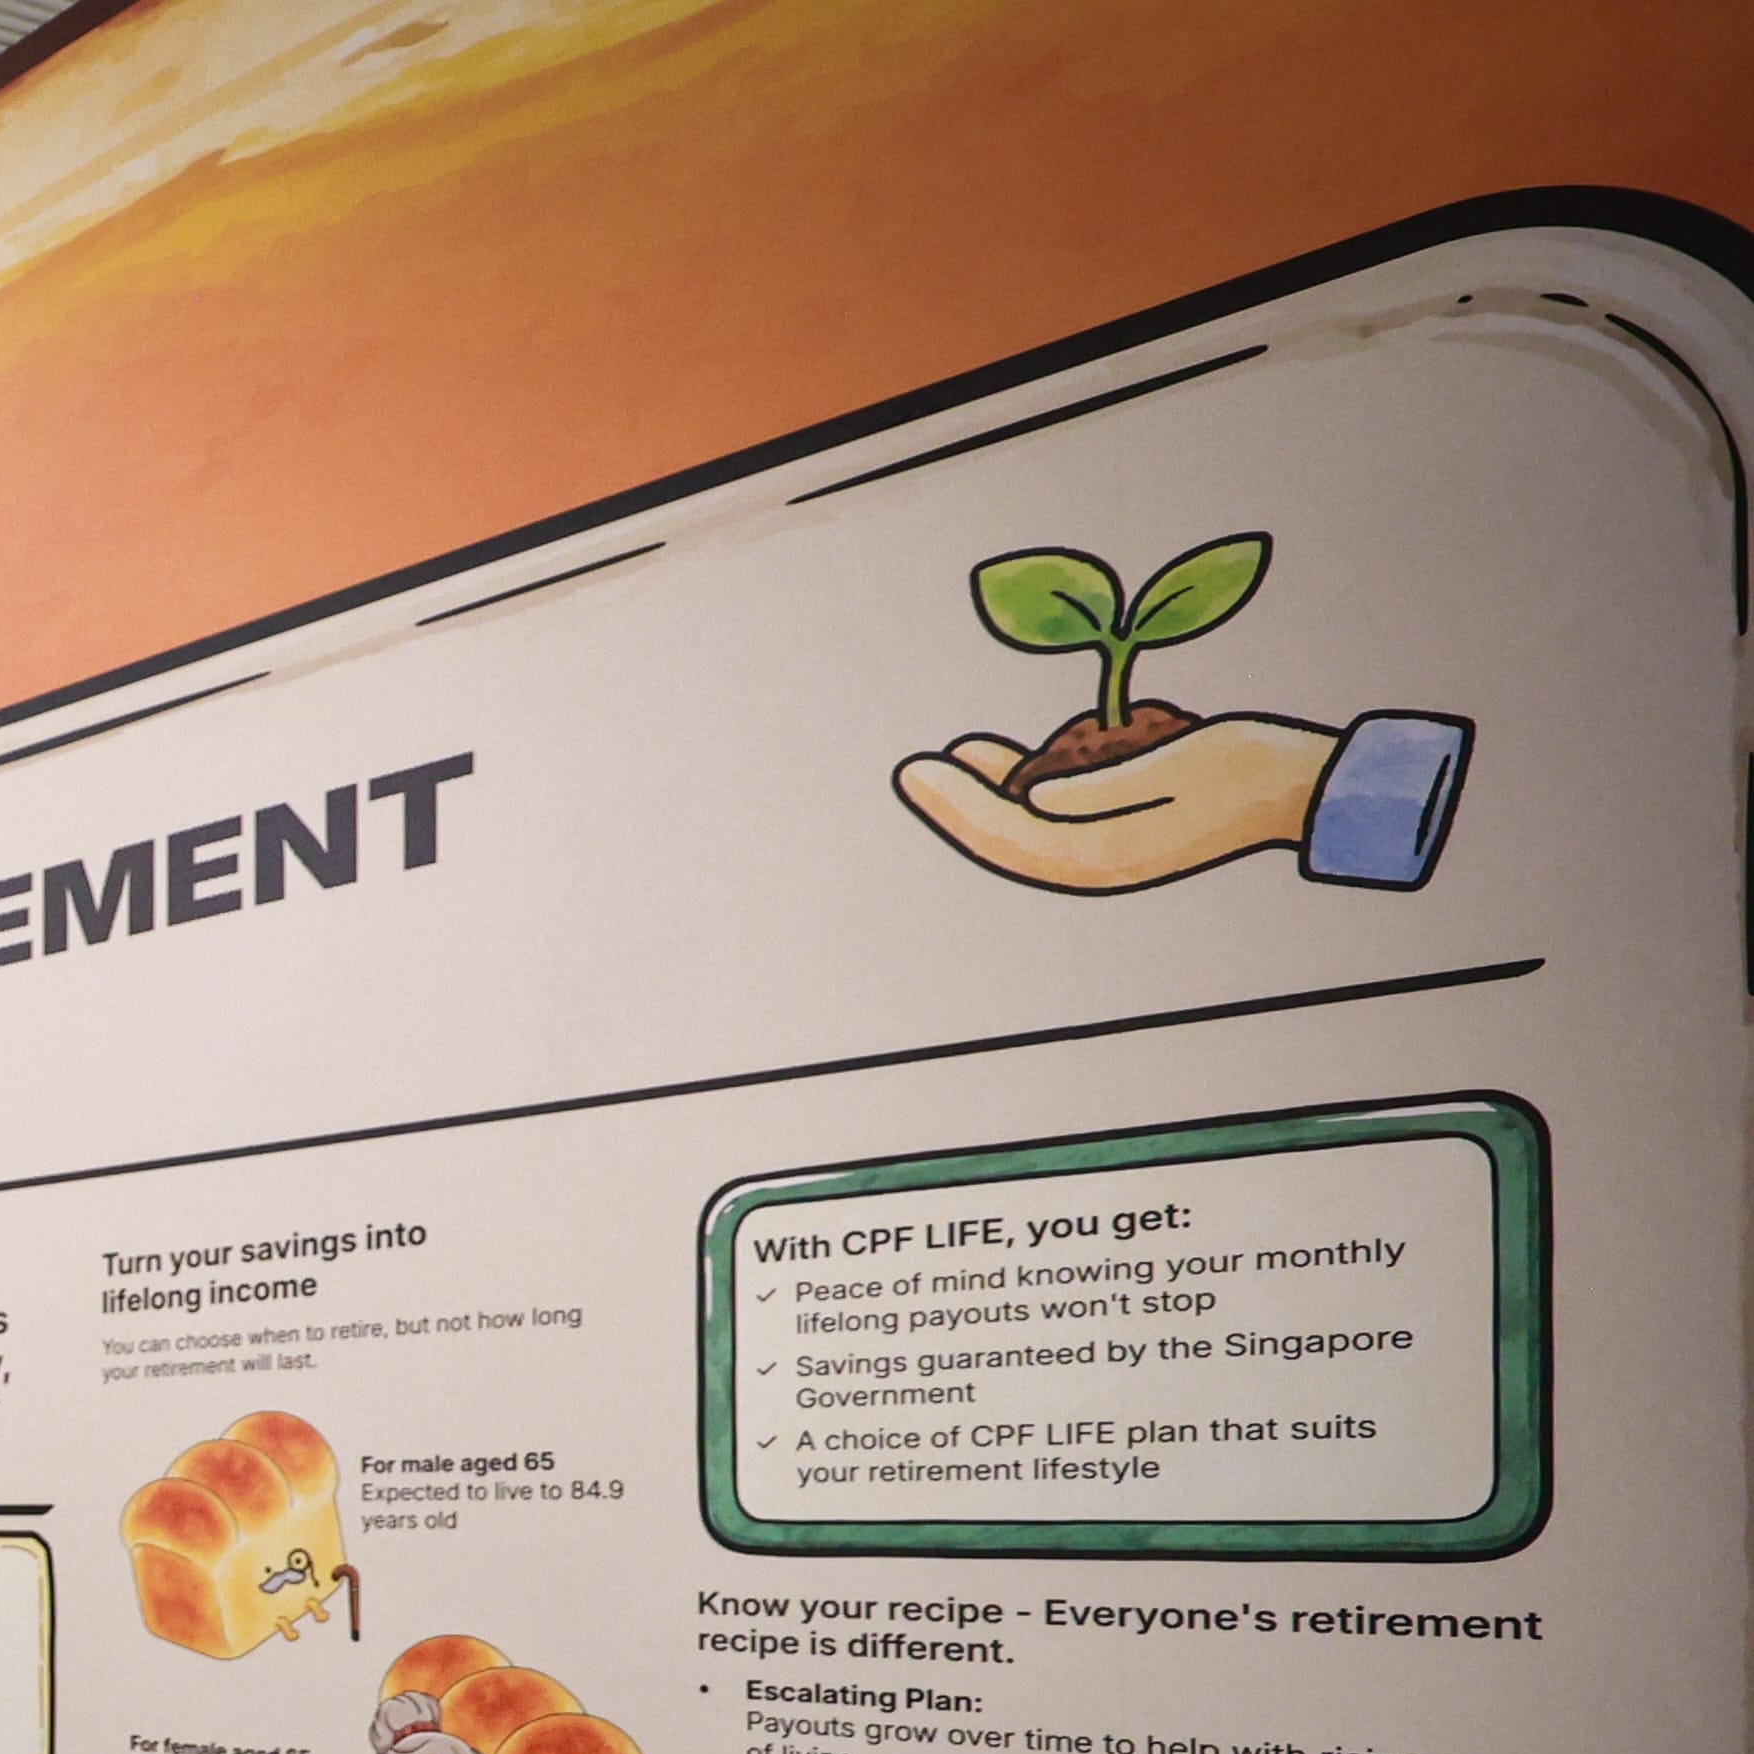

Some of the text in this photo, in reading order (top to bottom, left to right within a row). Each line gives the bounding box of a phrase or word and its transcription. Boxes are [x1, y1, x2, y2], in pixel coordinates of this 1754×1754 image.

[102, 1223, 426, 1276] Turn your savings into
[753, 1203, 1190, 1263] With CPF LIFE, you get:
[796, 1238, 1405, 1302] Peace of mind knowing your monthly
[103, 1277, 316, 1313] lifelong income
[797, 1291, 1215, 1334] lifelong payouts won't stop
[796, 1330, 1412, 1378] Savings guaranteed by the Singapore
[796, 1382, 975, 1408] Government
[795, 1414, 1376, 1451] A choice of CPF LIFE plan that suits
[361, 1451, 554, 1475] For male aged 65
[797, 1455, 1159, 1487] your retirement lifestyle
[698, 1591, 789, 1616] Know
[800, 1599, 877, 1624] your
[888, 1596, 1002, 1629] recipe
[1045, 1599, 1277, 1634] Everyone's
[1292, 1605, 1542, 1640] retirement
[698, 1628, 1013, 1663] recipe is different.
[746, 1679, 981, 1713] Escalating Plan:
[130, 1734, 158, 1752] For
